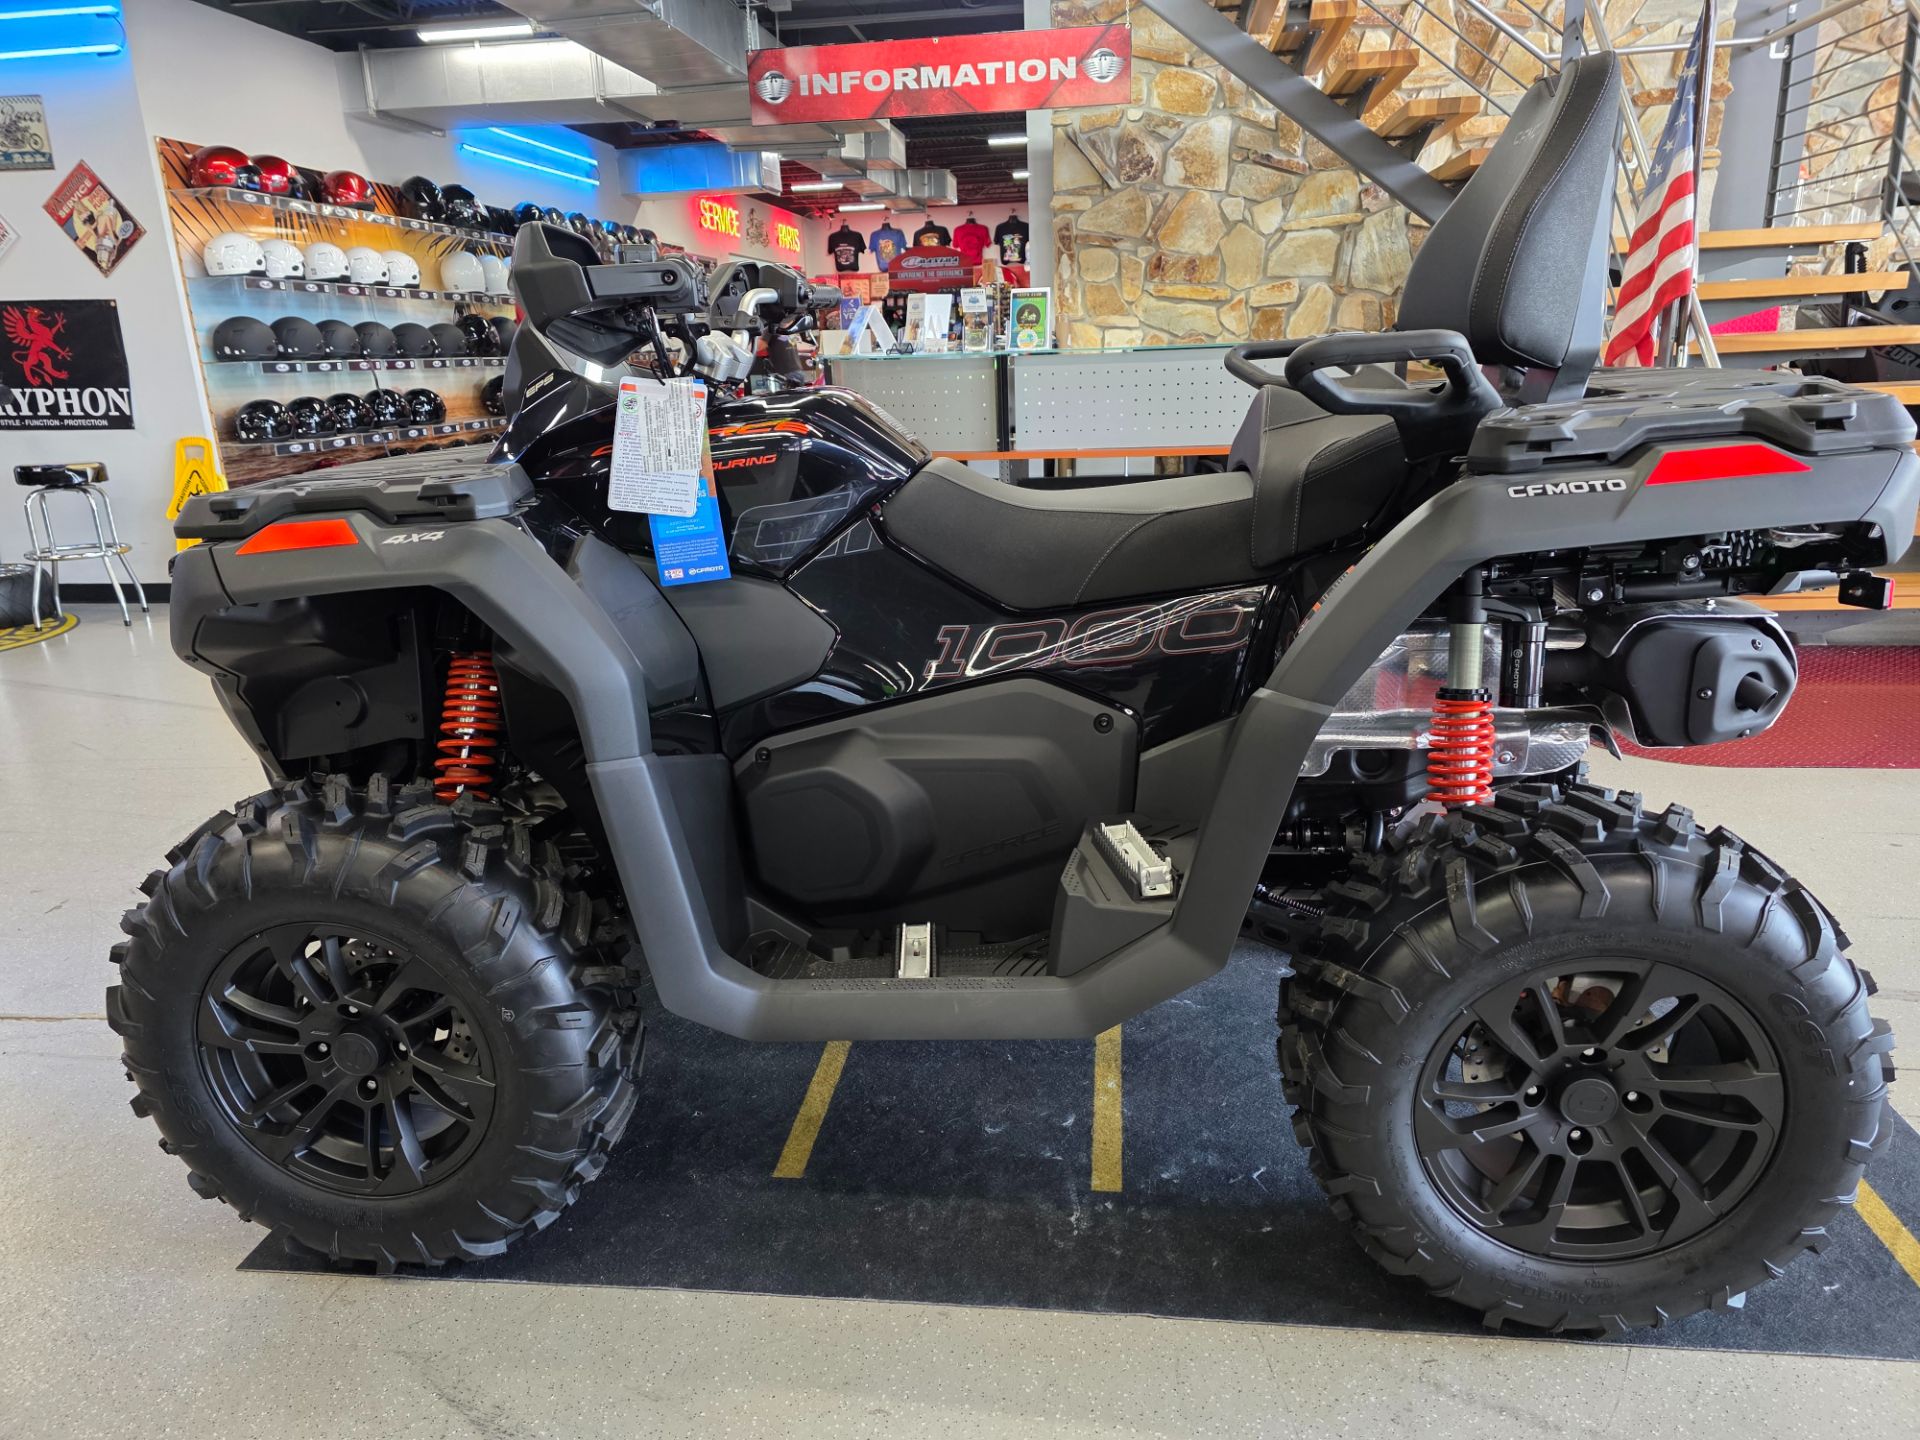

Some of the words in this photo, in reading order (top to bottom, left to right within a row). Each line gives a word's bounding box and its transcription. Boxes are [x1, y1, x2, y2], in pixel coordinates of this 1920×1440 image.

[799, 56, 1077, 96] INFORMATION
[58, 178, 93, 219] SERVICE
[700, 199, 741, 238] SERVICE
[777, 223, 800, 252] PARTS
[526, 372, 554, 398] EPS
[0, 418, 20, 426] STYLE
[25, 418, 60, 426] FUNCTION
[64, 418, 109, 426] PROTECTION
[1507, 479, 1627, 498] CFMOTO
[696, 565, 724, 574] CFMOTO
[924, 598, 1254, 677] 1000
